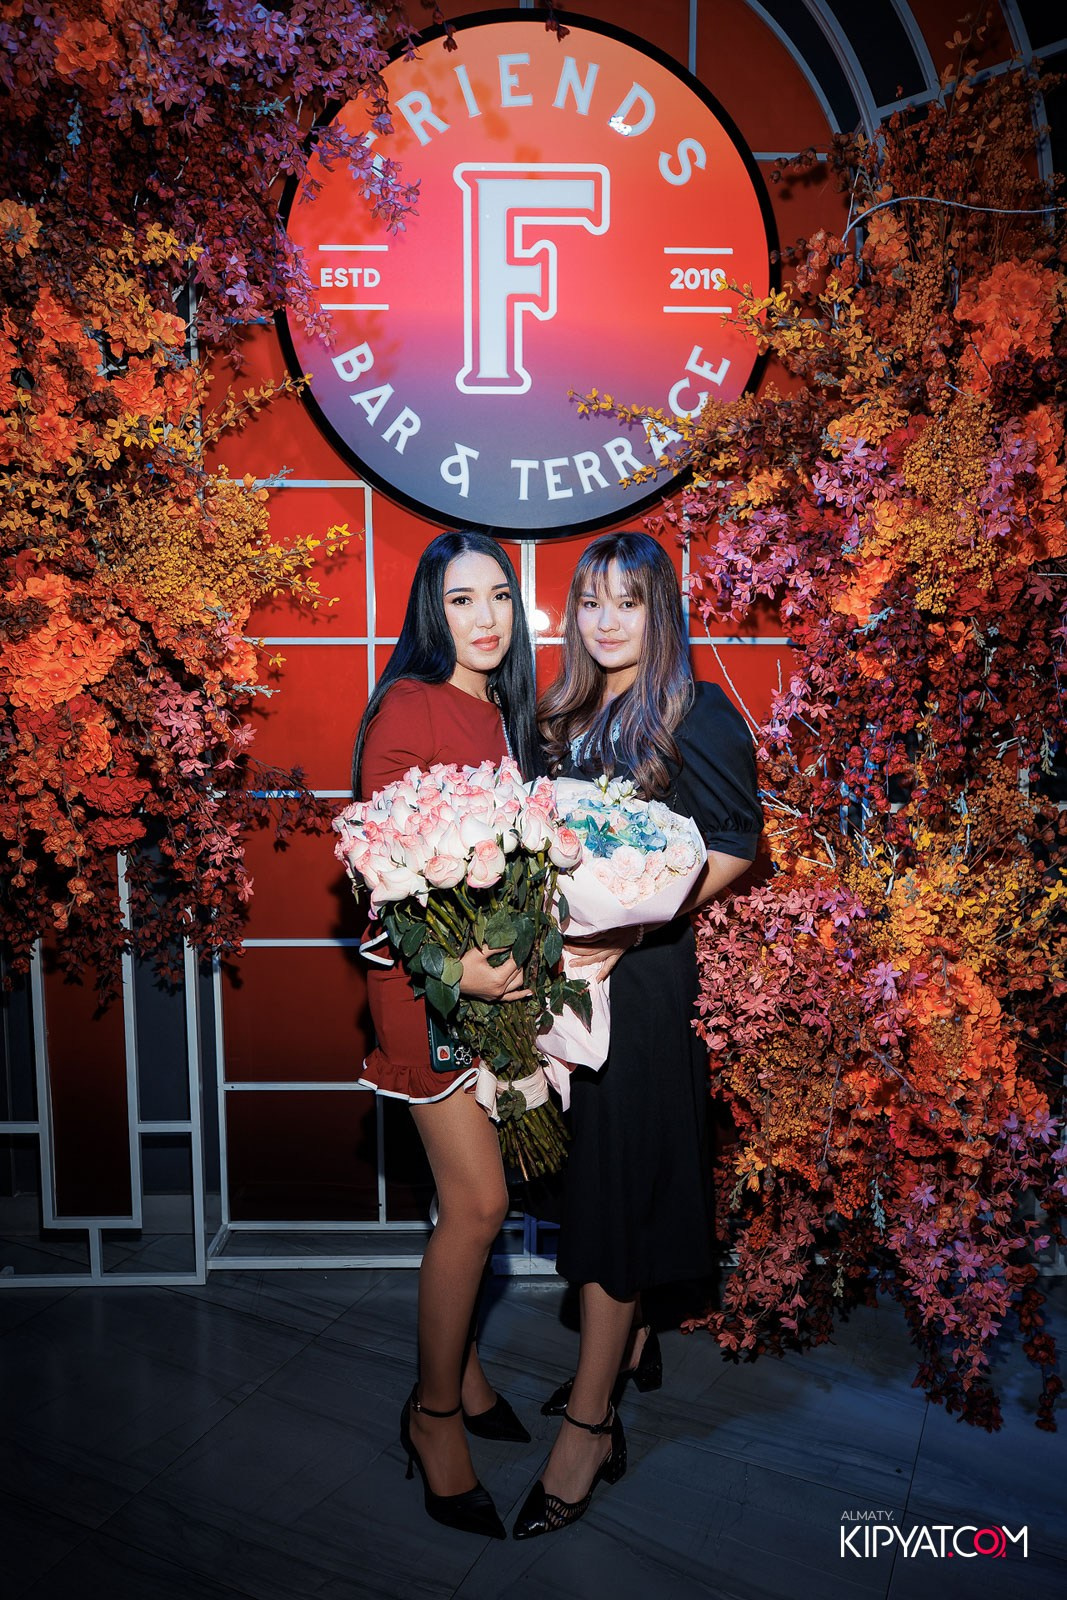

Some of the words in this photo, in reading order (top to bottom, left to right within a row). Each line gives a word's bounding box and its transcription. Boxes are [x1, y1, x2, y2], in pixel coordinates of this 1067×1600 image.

[320, 267, 381, 288] ESTD
[453, 162, 610, 395] F
[670, 267, 726, 290] 2019
[331, 341, 421, 455] BAR
[510, 344, 731, 501] TERRACE
